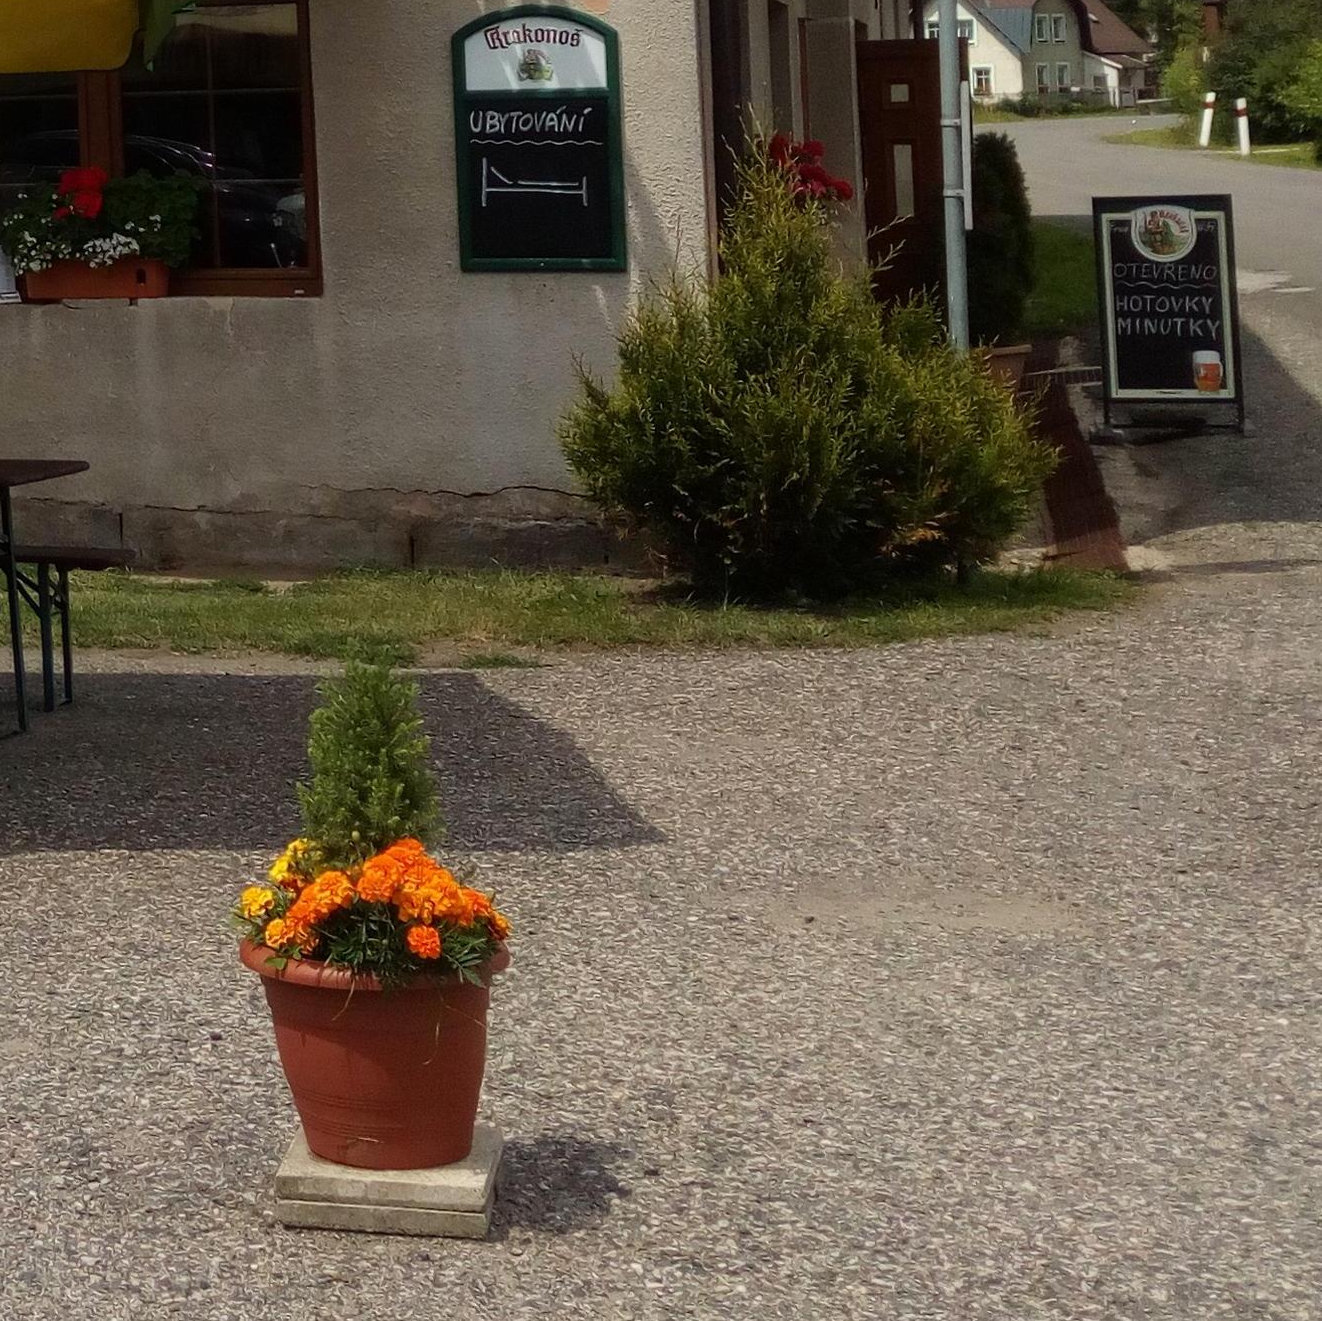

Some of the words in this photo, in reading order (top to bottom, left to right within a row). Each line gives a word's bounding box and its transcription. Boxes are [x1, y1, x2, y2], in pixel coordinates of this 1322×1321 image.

[483, 24, 583, 50] Krakonoš
[470, 105, 593, 134] UBYTOVÁNÍ
[1116, 295, 1214, 315] HOTOVKY
[1117, 317, 1220, 341] MINUTKY
